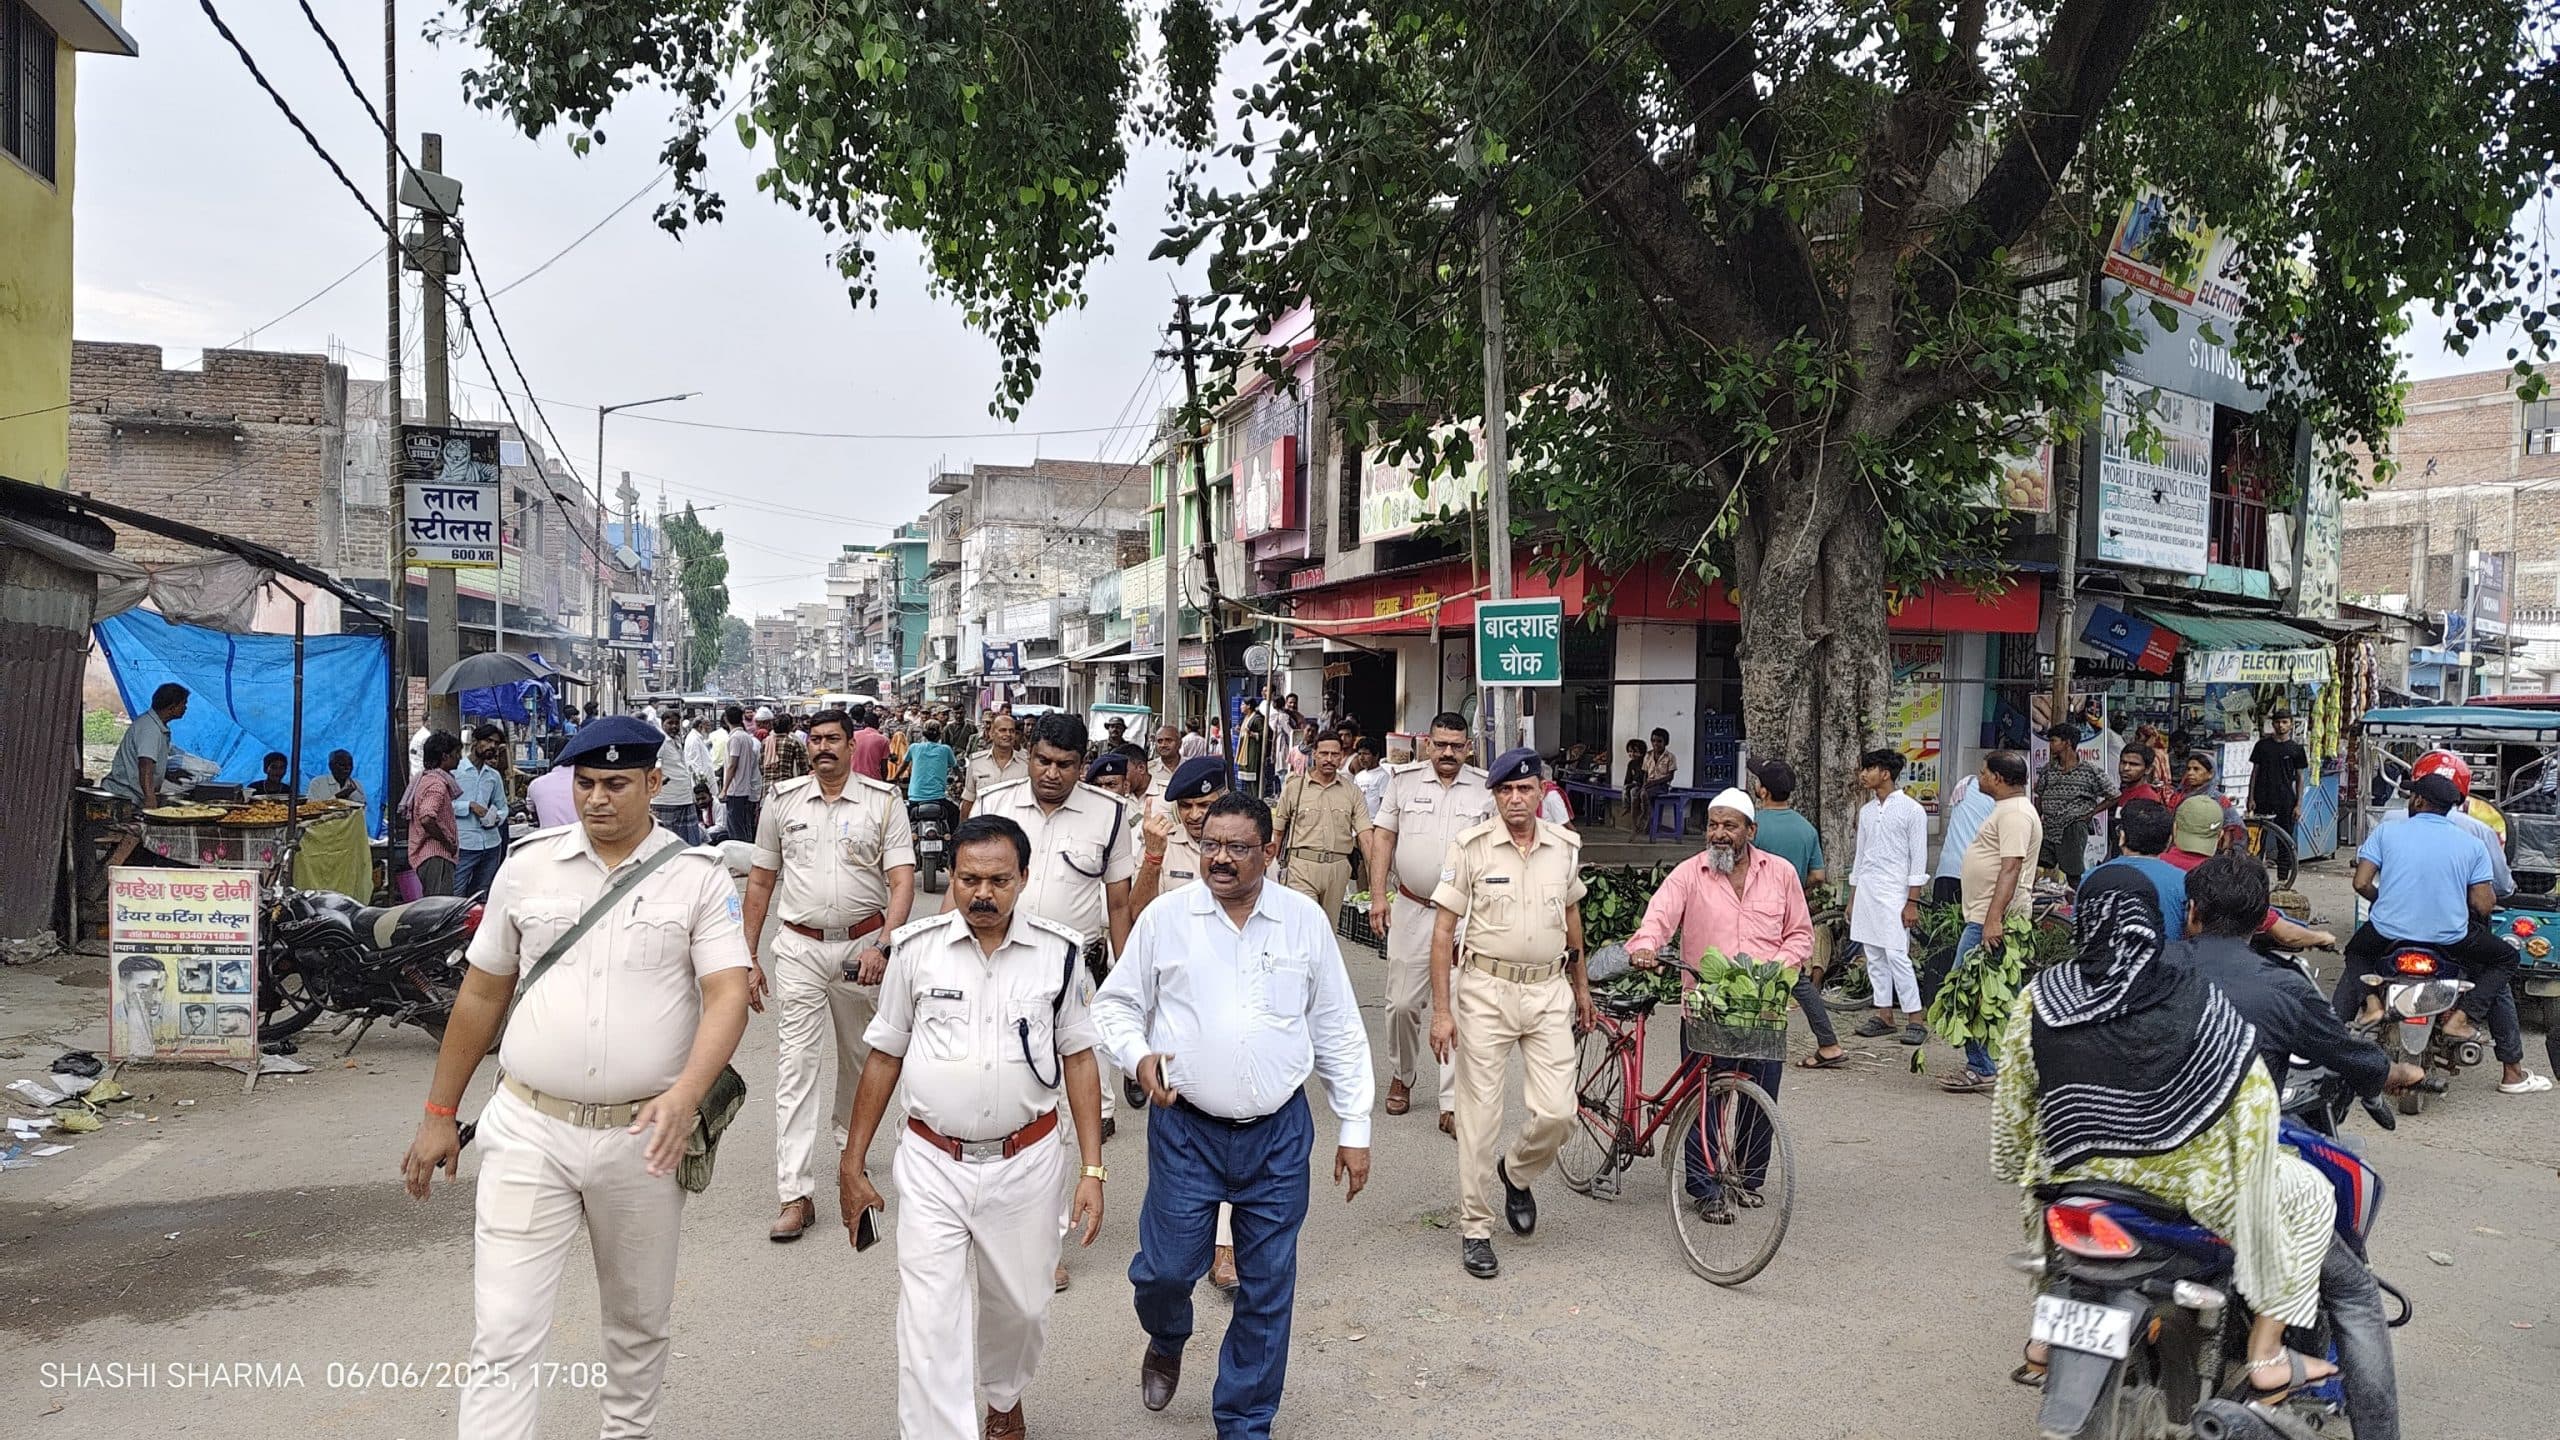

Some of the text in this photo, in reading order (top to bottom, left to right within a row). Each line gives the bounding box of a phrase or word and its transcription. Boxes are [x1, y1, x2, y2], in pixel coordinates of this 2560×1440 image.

[411, 449, 436, 460] STEELS
[414, 437, 433, 448] LALL
[2103, 464, 2208, 502] MOBILE REPAIRING CENTRE
[420, 487, 480, 512] लाल
[407, 511, 493, 542] स्टीलस
[451, 550, 494, 561] 600 XR
[1483, 614, 1559, 639] बादशाह
[2111, 624, 2127, 636] Jio
[1498, 644, 1544, 675] चौक
[2088, 657, 2173, 674] SAMSG
[2246, 673, 2267, 681] MOBILE
[115, 877, 254, 901] महेश एण्ड टोनी
[2053, 1301, 2106, 1328] JH17
